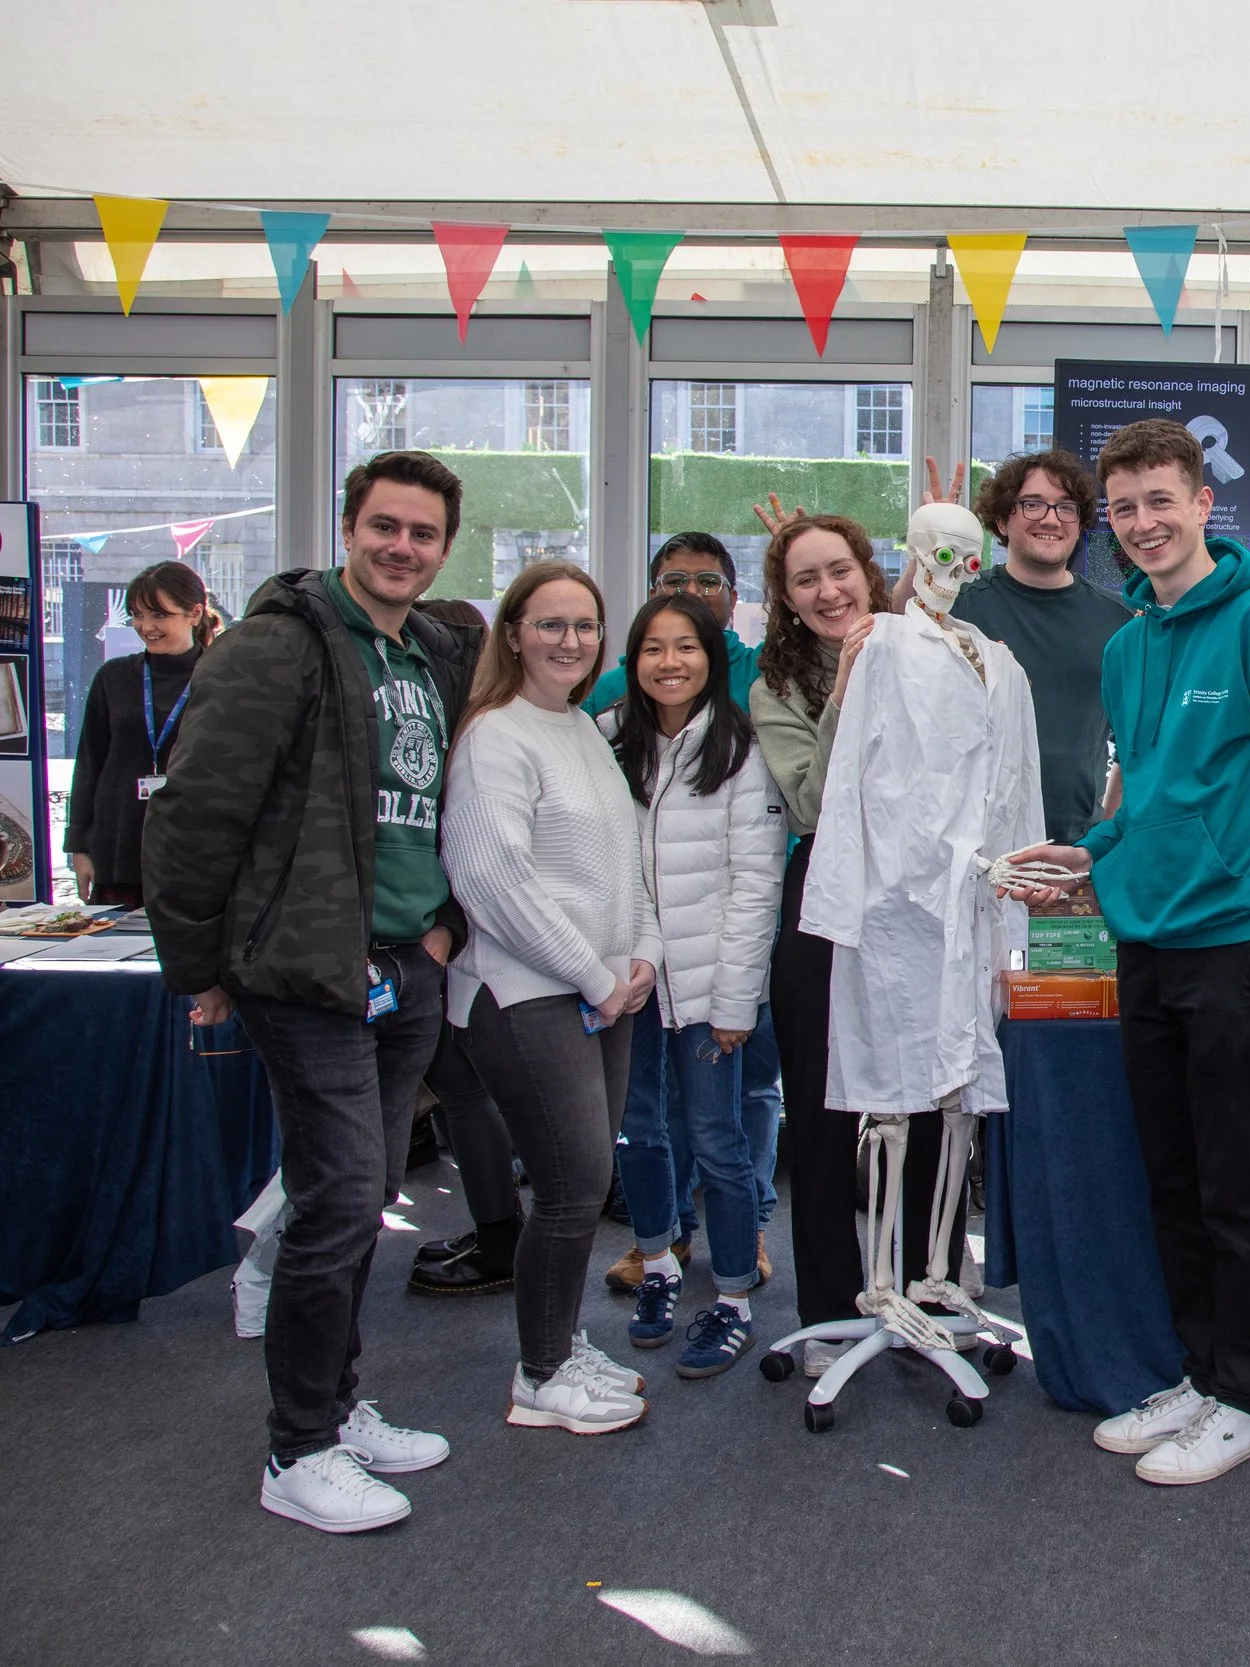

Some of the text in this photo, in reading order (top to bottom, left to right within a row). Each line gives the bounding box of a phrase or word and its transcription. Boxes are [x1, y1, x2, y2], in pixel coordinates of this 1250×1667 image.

[1068, 378, 1246, 396] magnetic resonance imaging
[1071, 398, 1182, 412] microstructural insight
